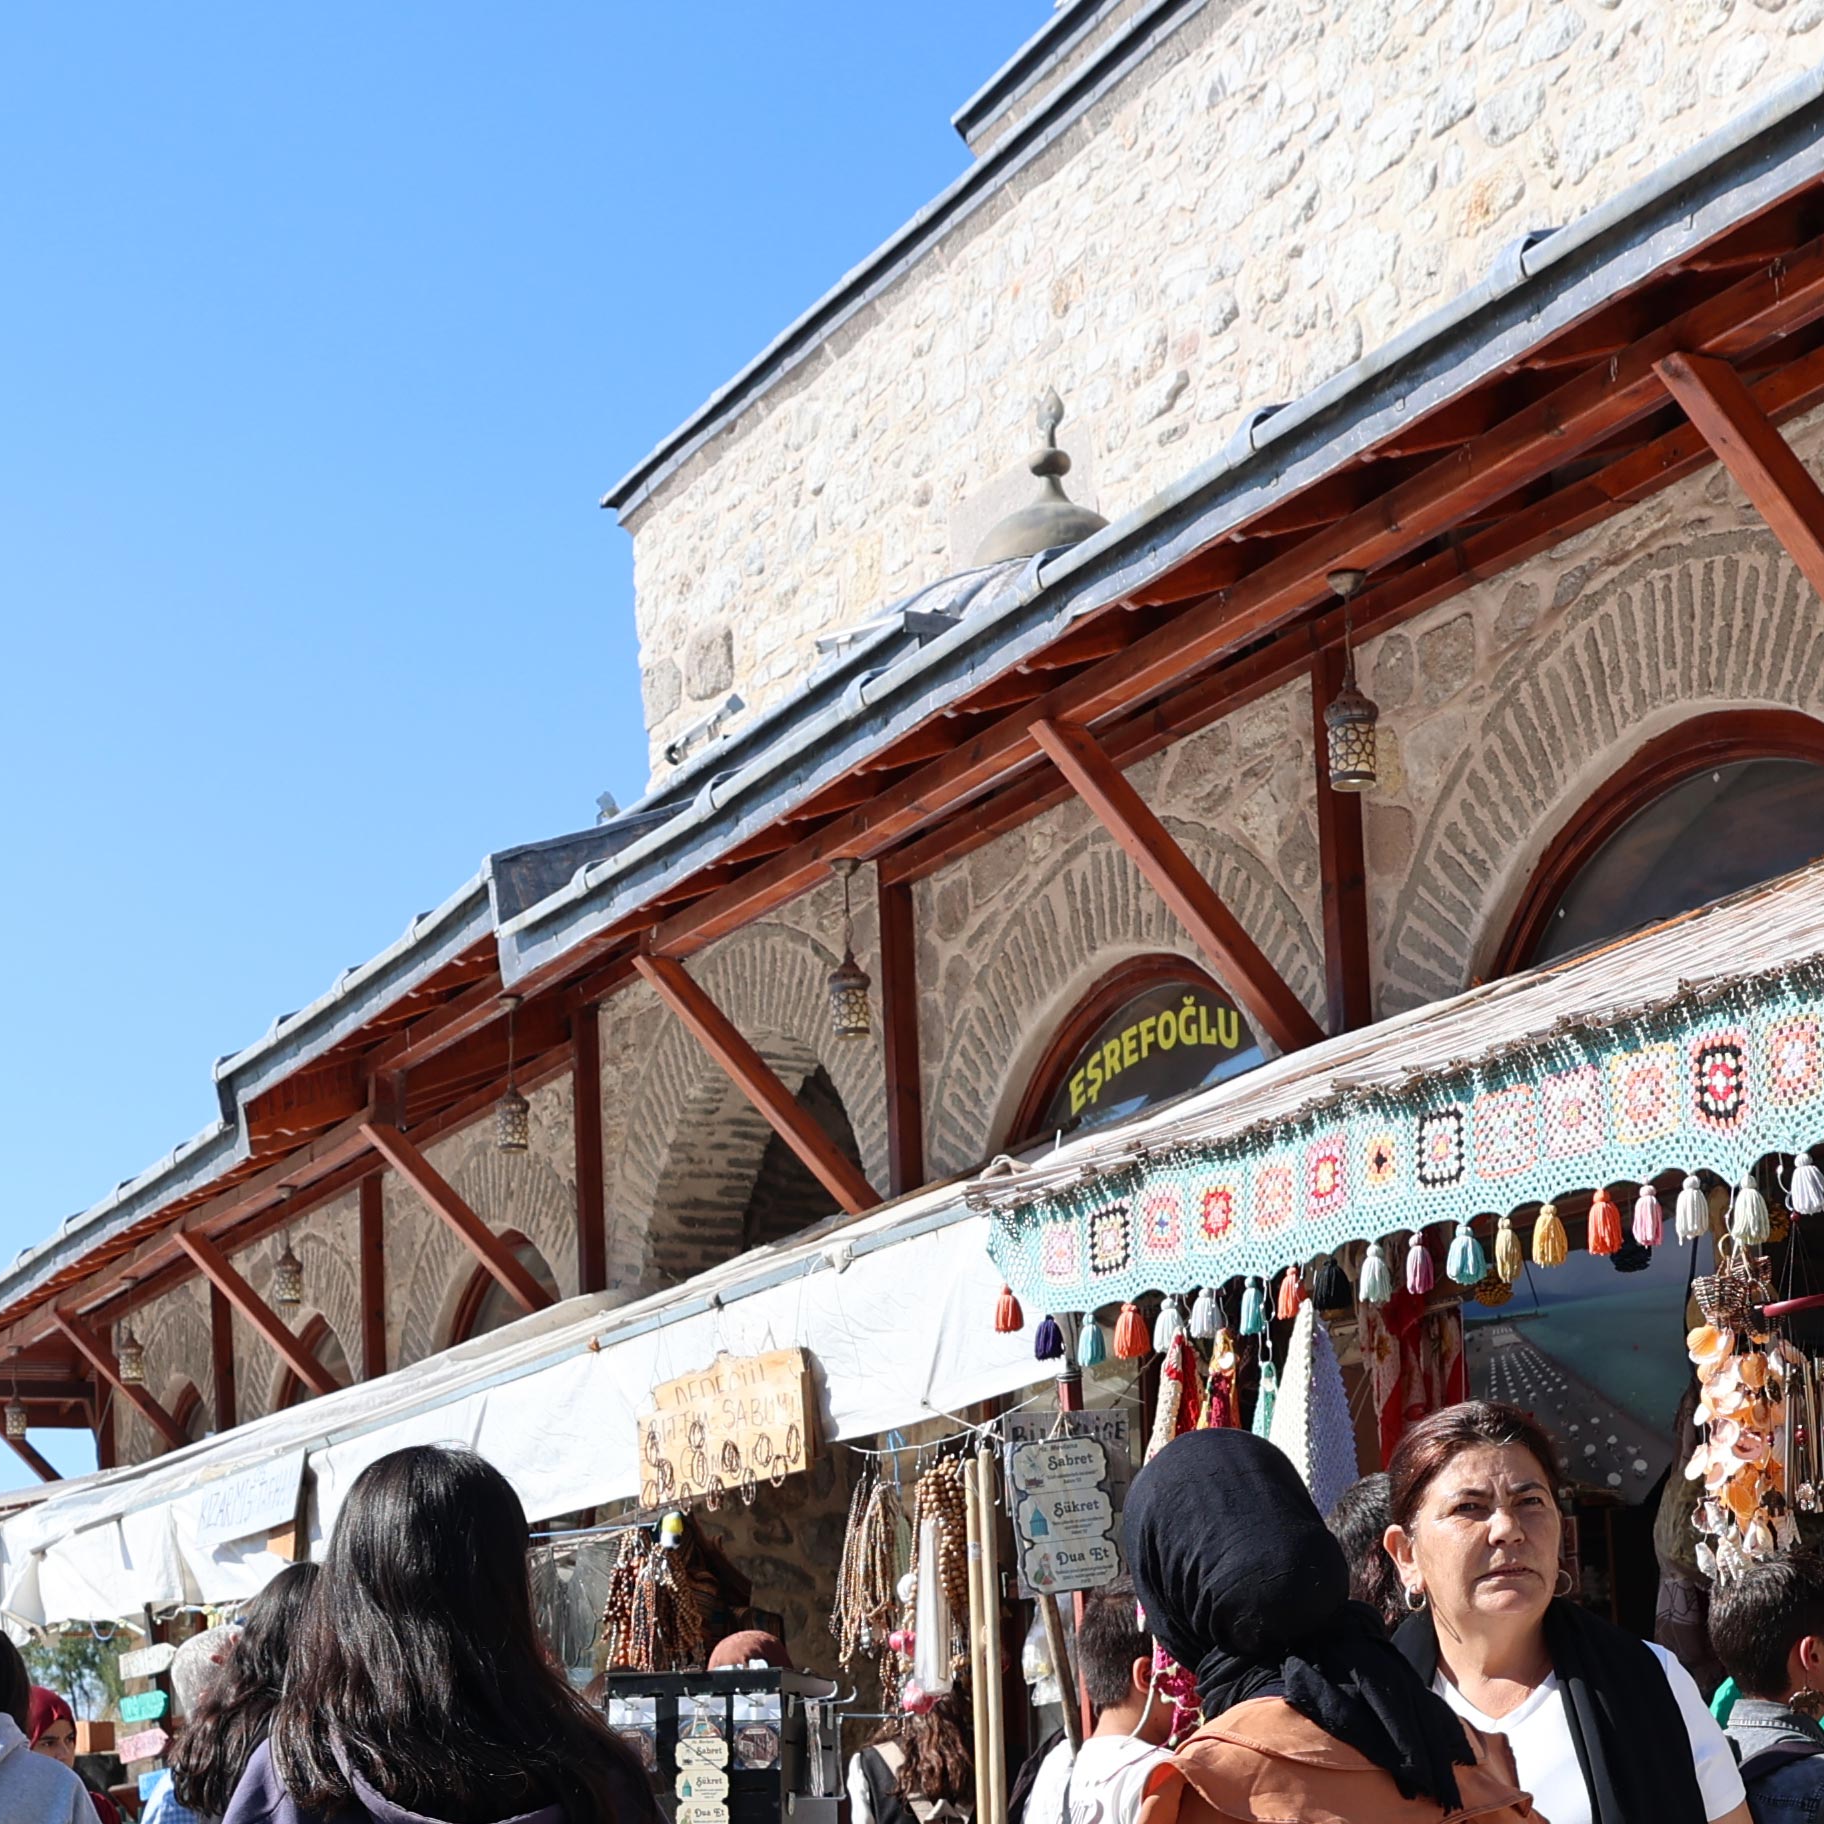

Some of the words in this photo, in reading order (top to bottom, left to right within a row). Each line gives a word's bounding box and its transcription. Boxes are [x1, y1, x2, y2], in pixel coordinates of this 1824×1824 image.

[1069, 996, 1239, 1116] EŞREFOĞLU
[1048, 1453, 1093, 1471] Sabret
[1056, 1551, 1085, 1566] Dua
[1089, 1547, 1110, 1561] Et
[694, 1808, 711, 1818] Dua
